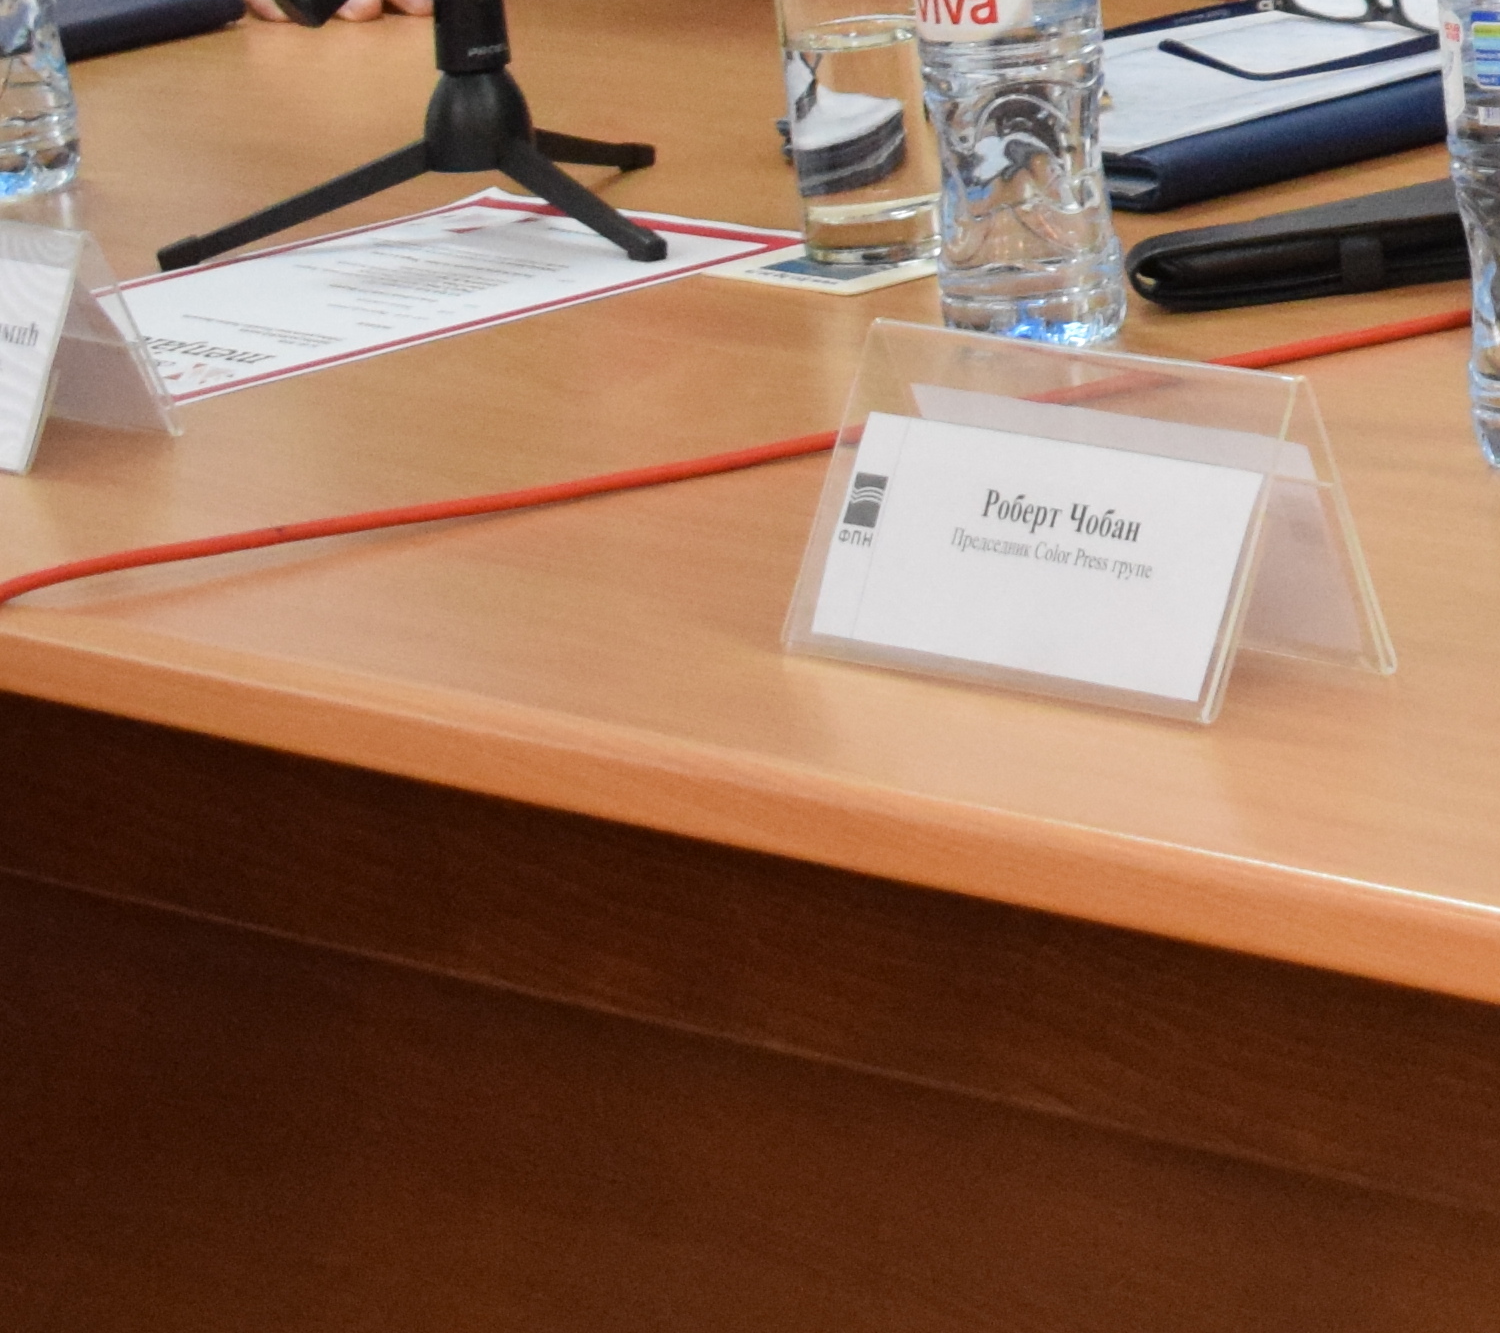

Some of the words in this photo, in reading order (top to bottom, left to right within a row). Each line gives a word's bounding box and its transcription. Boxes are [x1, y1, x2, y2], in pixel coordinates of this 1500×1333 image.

[837, 528, 874, 549] ФПН
[981, 487, 1063, 533] Роберт
[1070, 501, 1142, 543] Чобан
[951, 526, 1033, 558] Председник
[1034, 540, 1072, 565] Color
[1073, 550, 1109, 572] Press
[1110, 561, 1154, 581] групе
